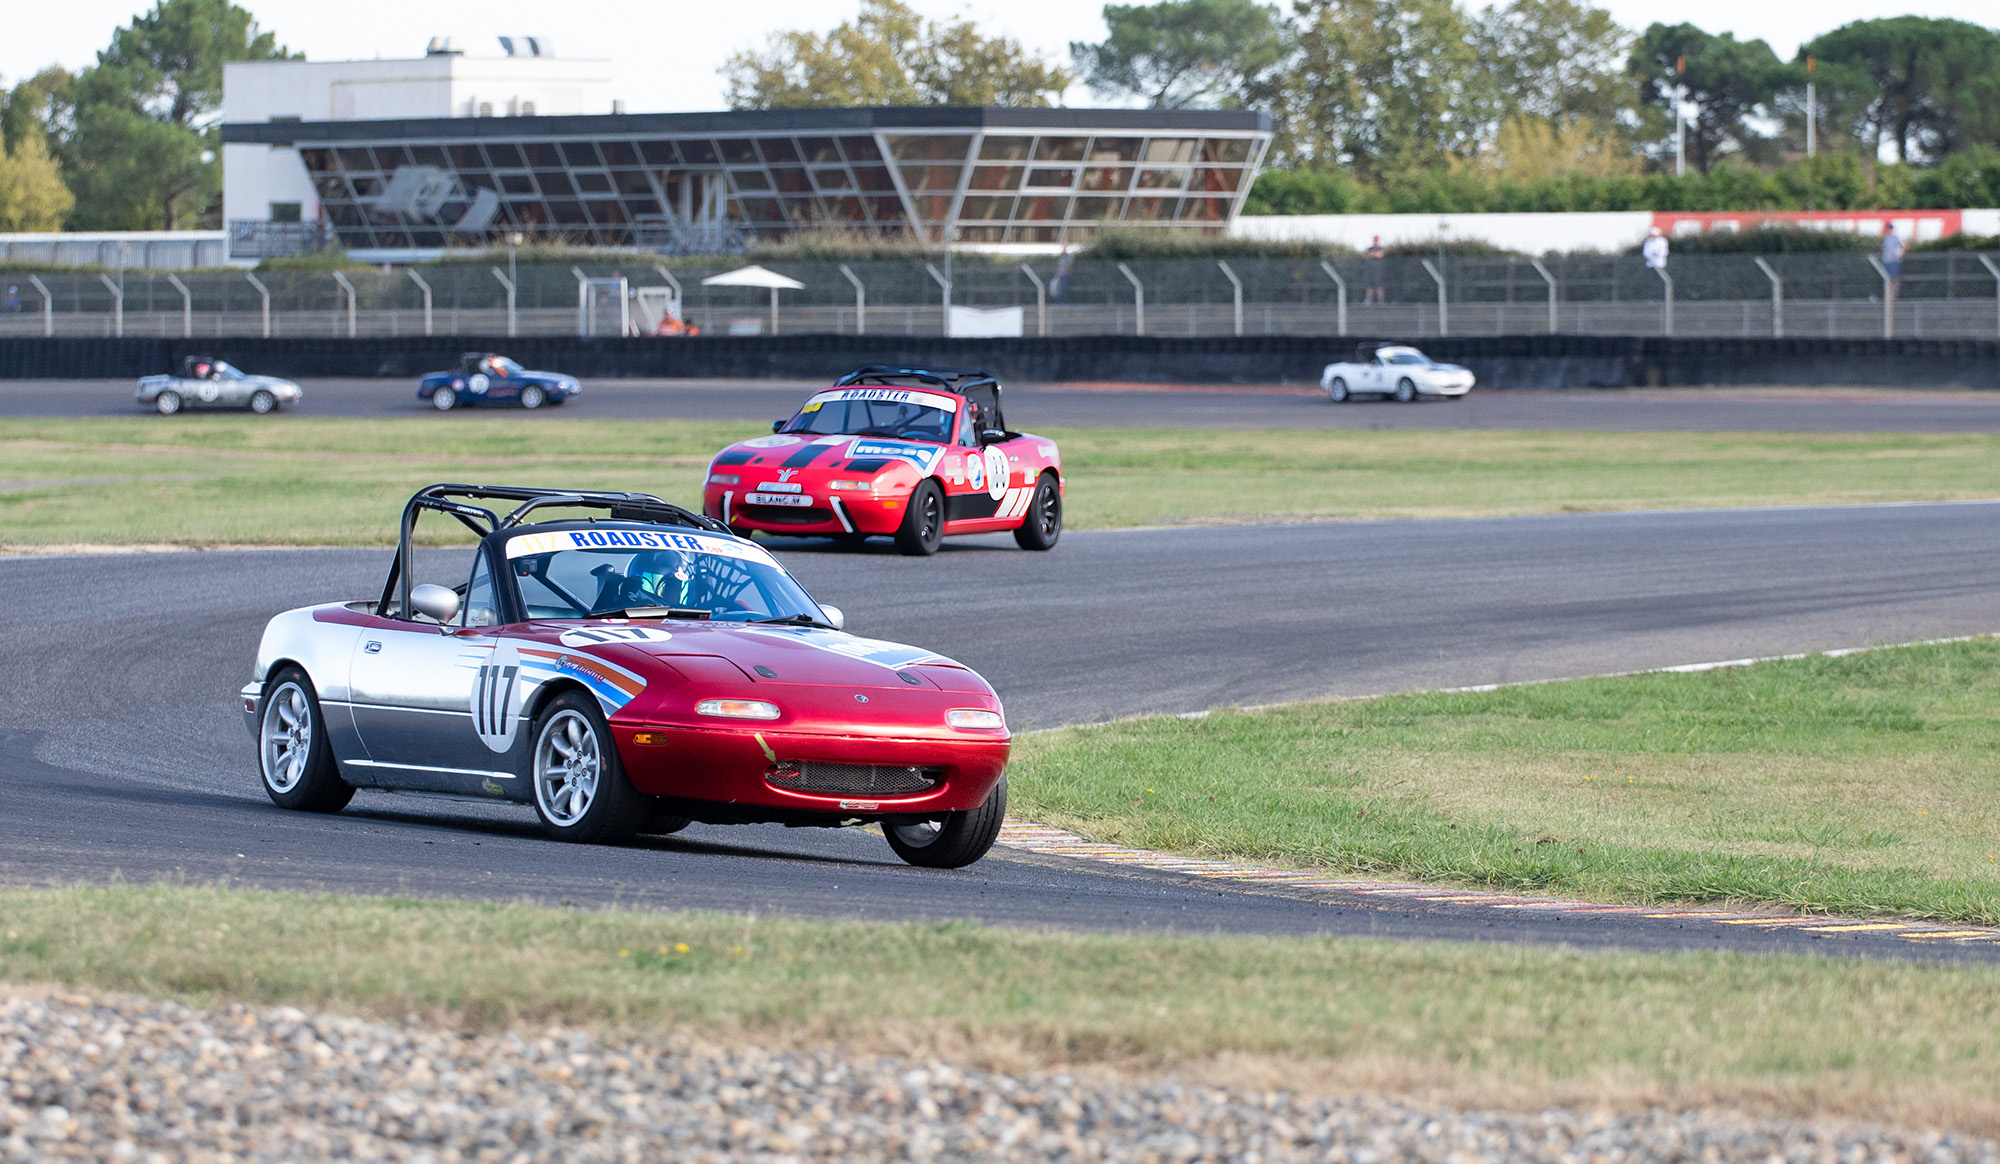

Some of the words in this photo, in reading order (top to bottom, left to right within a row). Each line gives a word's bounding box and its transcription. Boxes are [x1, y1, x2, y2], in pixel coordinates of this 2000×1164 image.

[841, 389, 911, 401] ROADSTER
[520, 533, 556, 553] 117
[568, 531, 704, 551] ROADSTER
[564, 628, 651, 642] 117
[478, 665, 519, 735] 117
